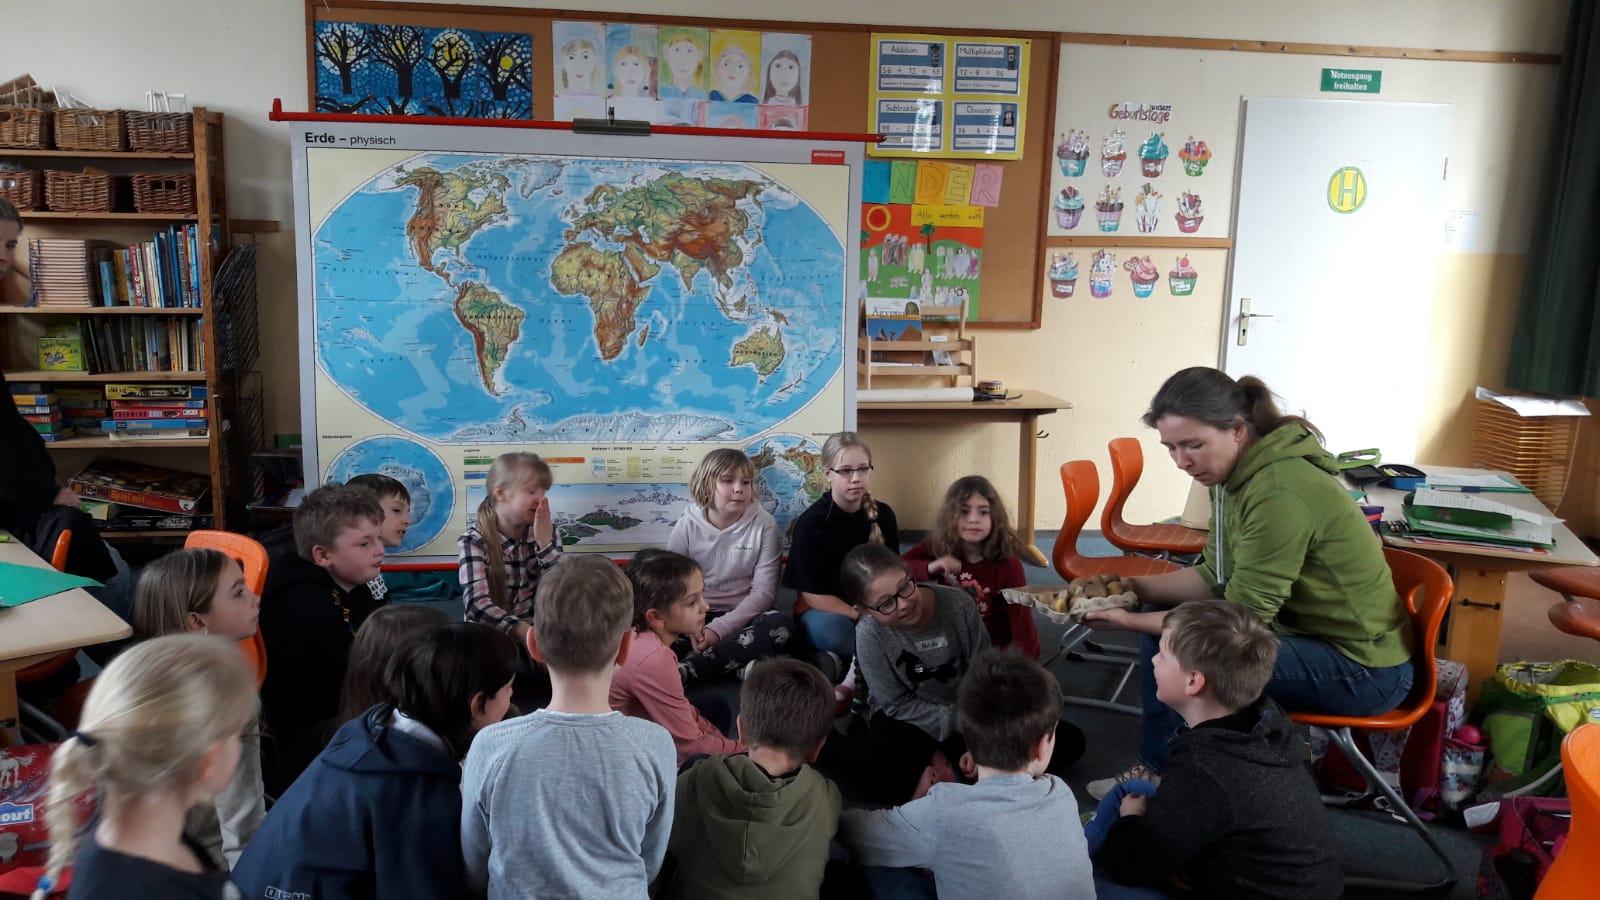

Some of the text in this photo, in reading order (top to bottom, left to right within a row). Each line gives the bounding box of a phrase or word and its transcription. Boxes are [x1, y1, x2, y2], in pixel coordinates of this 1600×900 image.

[1331, 70, 1372, 81] Notausgang
[1334, 81, 1367, 91] freihalten
[1108, 103, 1170, 124] Geburtstage
[305, 132, 335, 143] Erde
[350, 135, 396, 146] physisch
[1338, 168, 1357, 206] H
